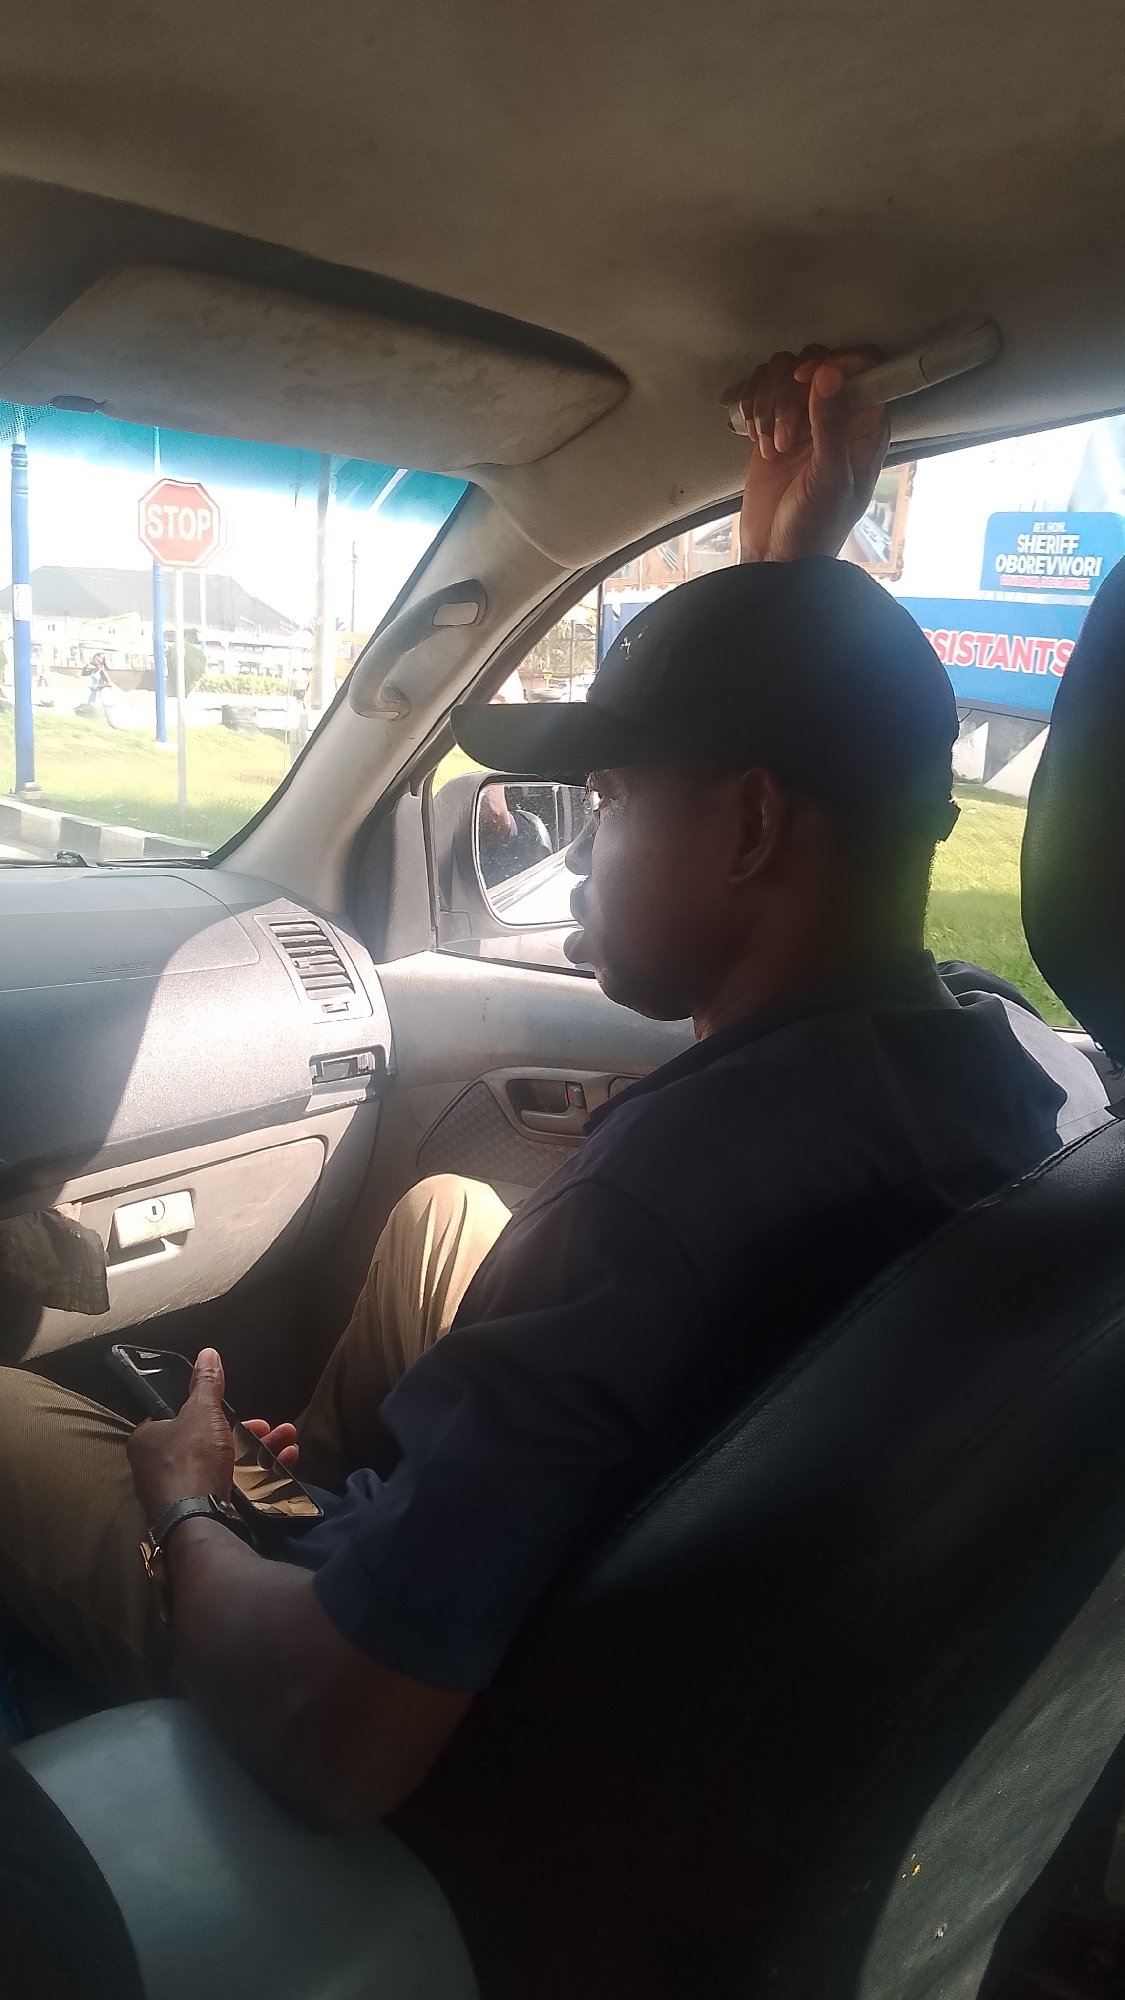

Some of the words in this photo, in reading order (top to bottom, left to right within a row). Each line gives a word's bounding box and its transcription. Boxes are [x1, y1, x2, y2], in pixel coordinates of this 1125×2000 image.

[147, 503, 212, 541] STOP
[1017, 534, 1079, 554] SHERIFF
[995, 554, 1103, 577] OBOREVWORI
